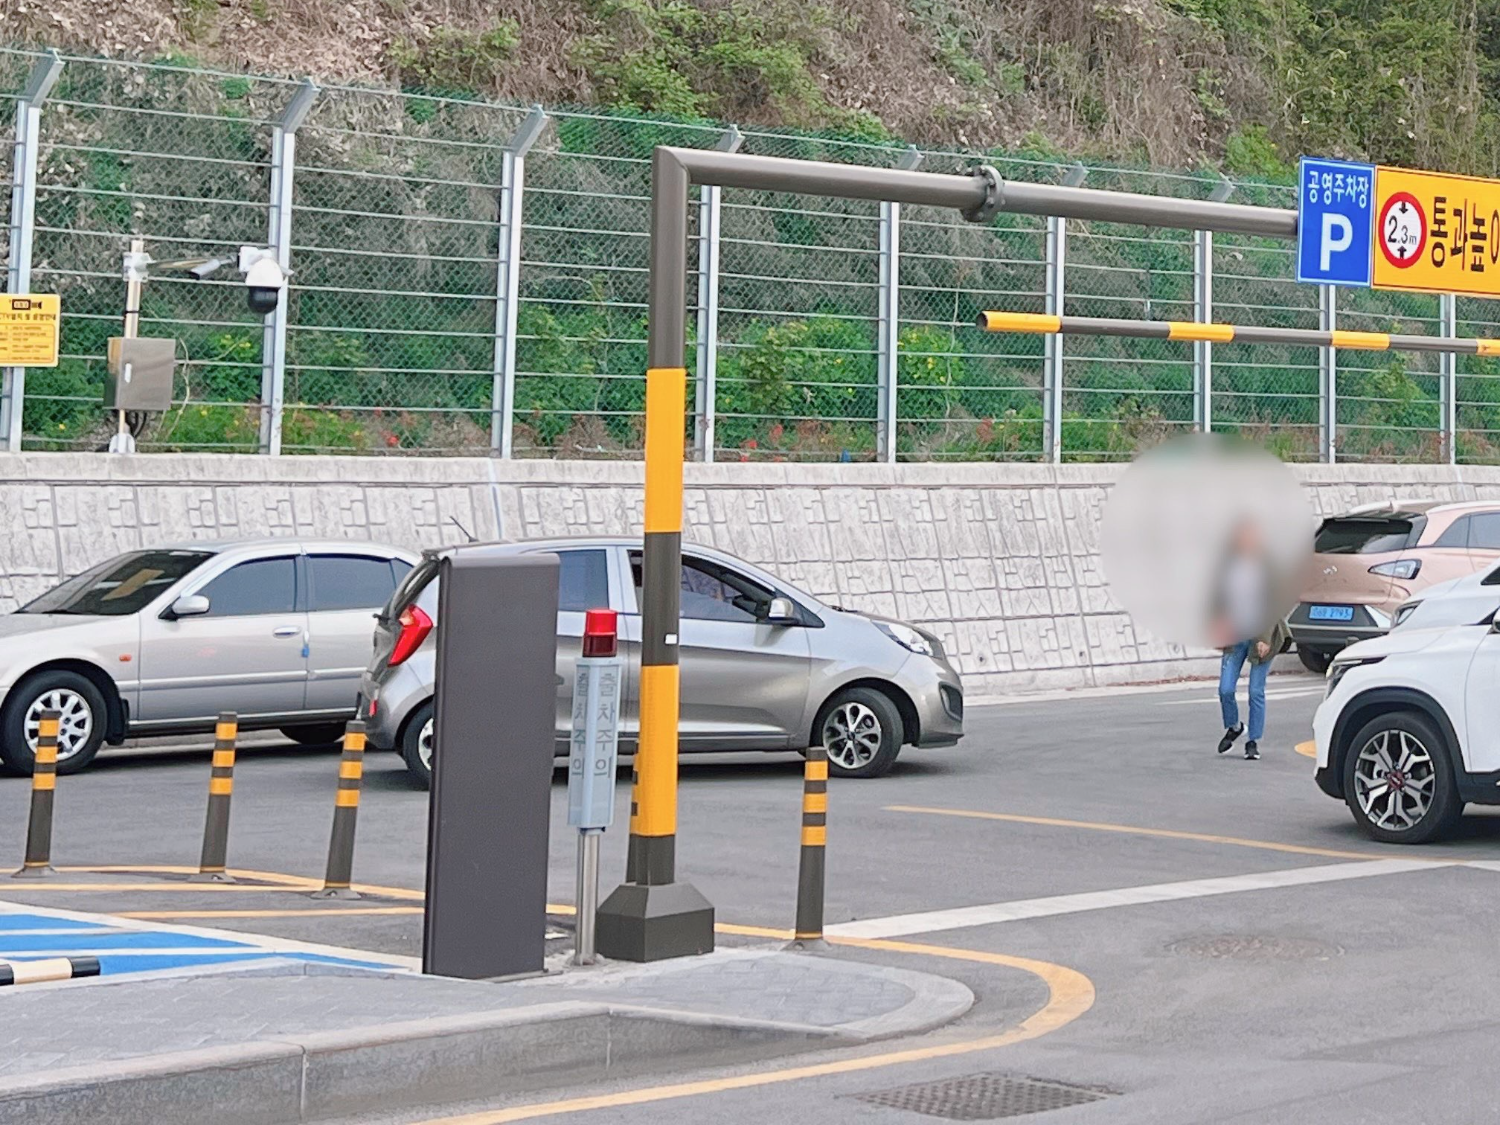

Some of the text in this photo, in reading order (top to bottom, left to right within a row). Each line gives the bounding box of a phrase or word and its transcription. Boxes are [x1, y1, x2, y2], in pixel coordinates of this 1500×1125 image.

[1307, 170, 1369, 209] 공영주차장
[1320, 212, 1354, 272] P
[1388, 214, 1418, 246] 2.3m
[593, 672, 616, 779] 출차주의
